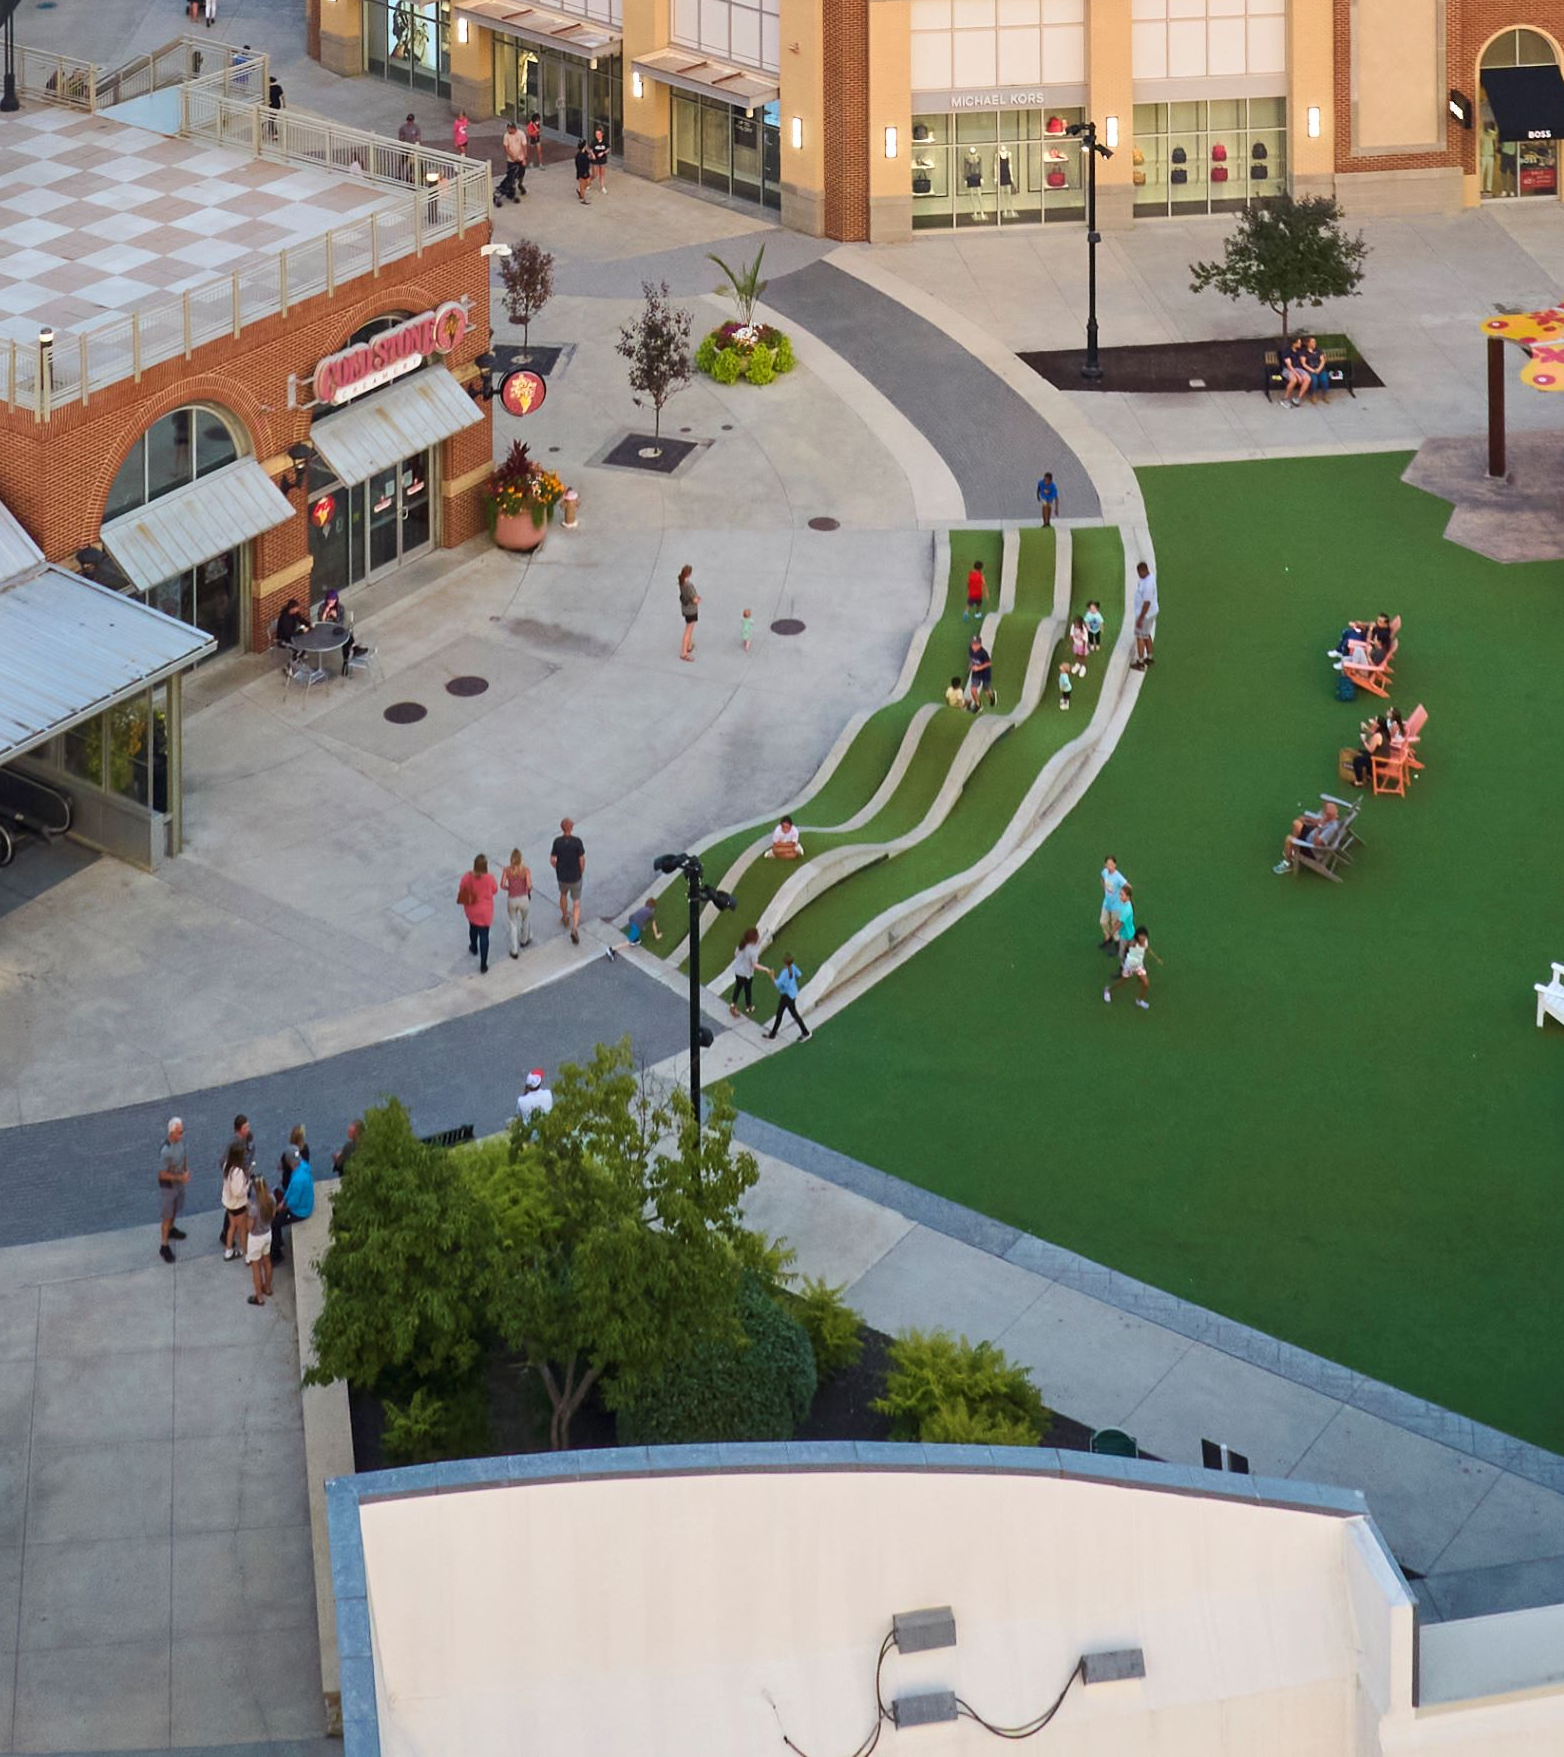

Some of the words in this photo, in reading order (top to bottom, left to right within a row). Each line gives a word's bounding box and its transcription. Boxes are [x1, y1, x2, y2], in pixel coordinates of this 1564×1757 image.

[951, 95, 1006, 107] MICHAEL
[1010, 93, 1045, 105] KORS
[1528, 129, 1552, 139] BOSS
[318, 347, 374, 403] COLD
[372, 318, 437, 371] STONE
[341, 358, 418, 399] CREAMERY
